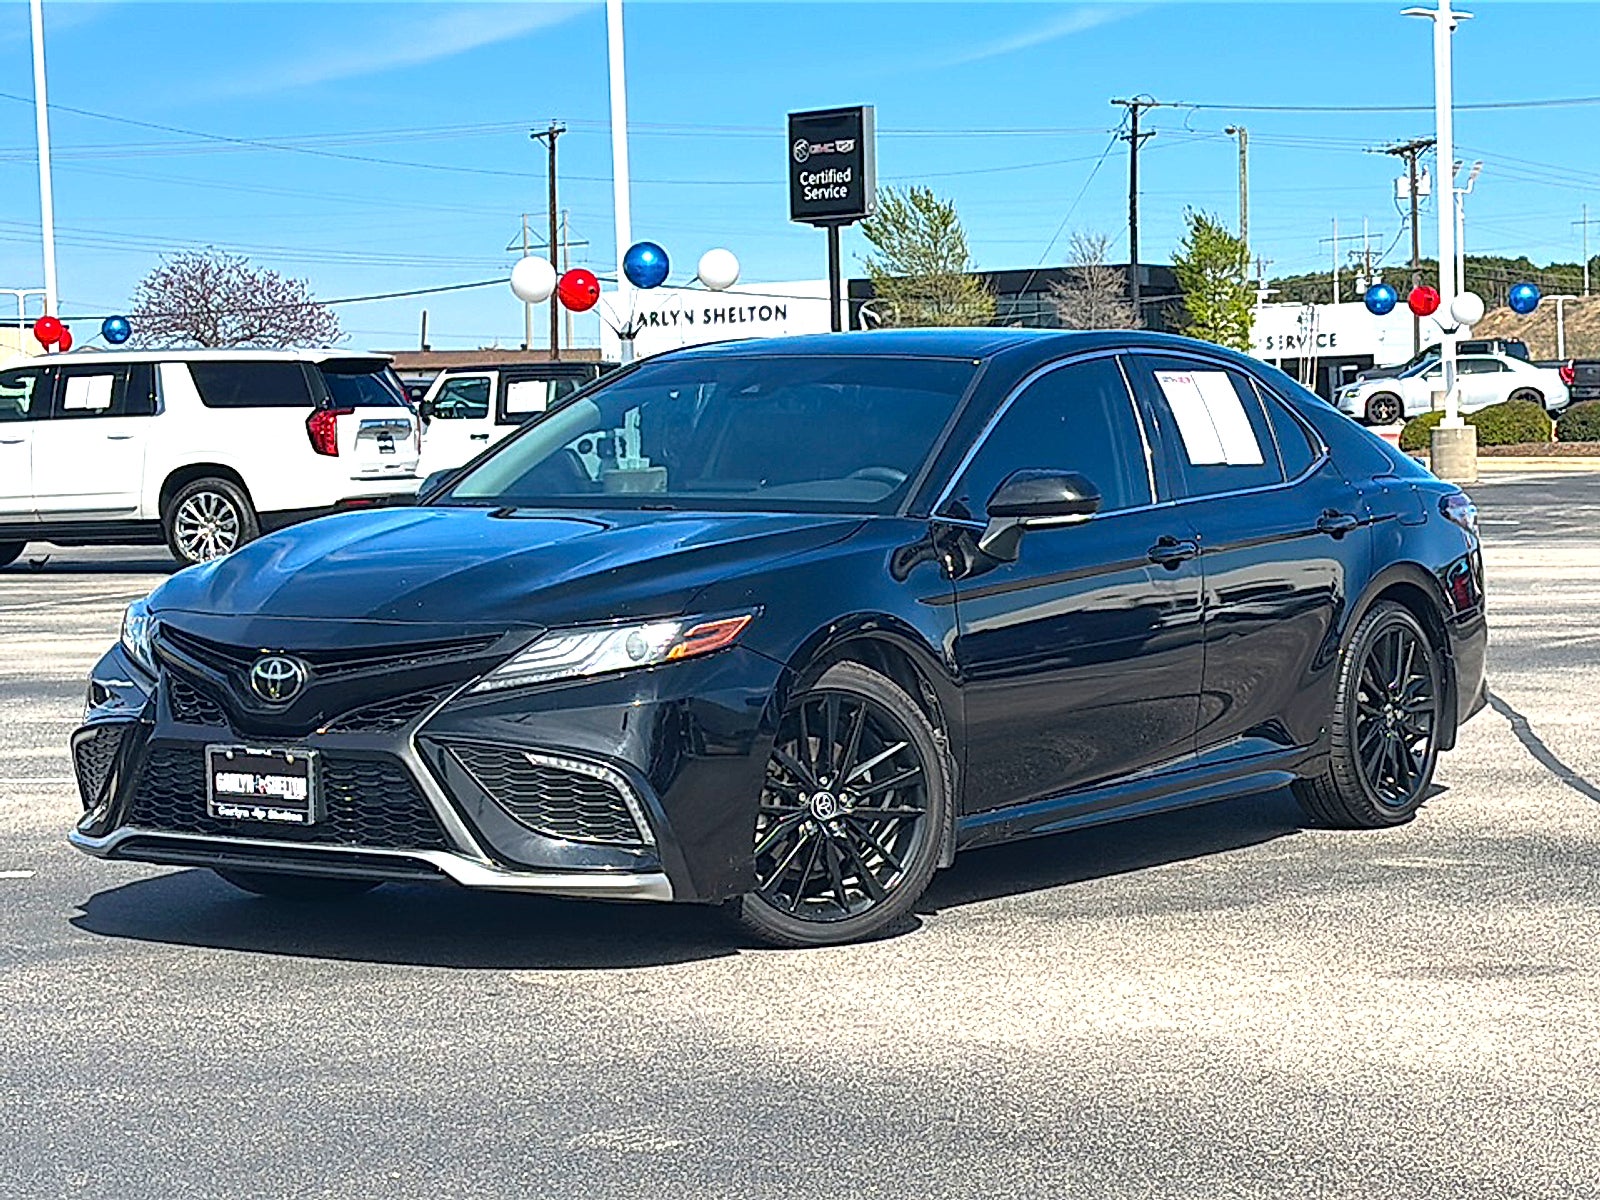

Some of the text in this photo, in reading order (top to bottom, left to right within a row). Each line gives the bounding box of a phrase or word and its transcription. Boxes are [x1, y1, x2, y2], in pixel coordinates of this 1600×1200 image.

[800, 167, 851, 186] Certified
[804, 184, 848, 201] Service
[636, 304, 787, 327] ARLYN SHELTON
